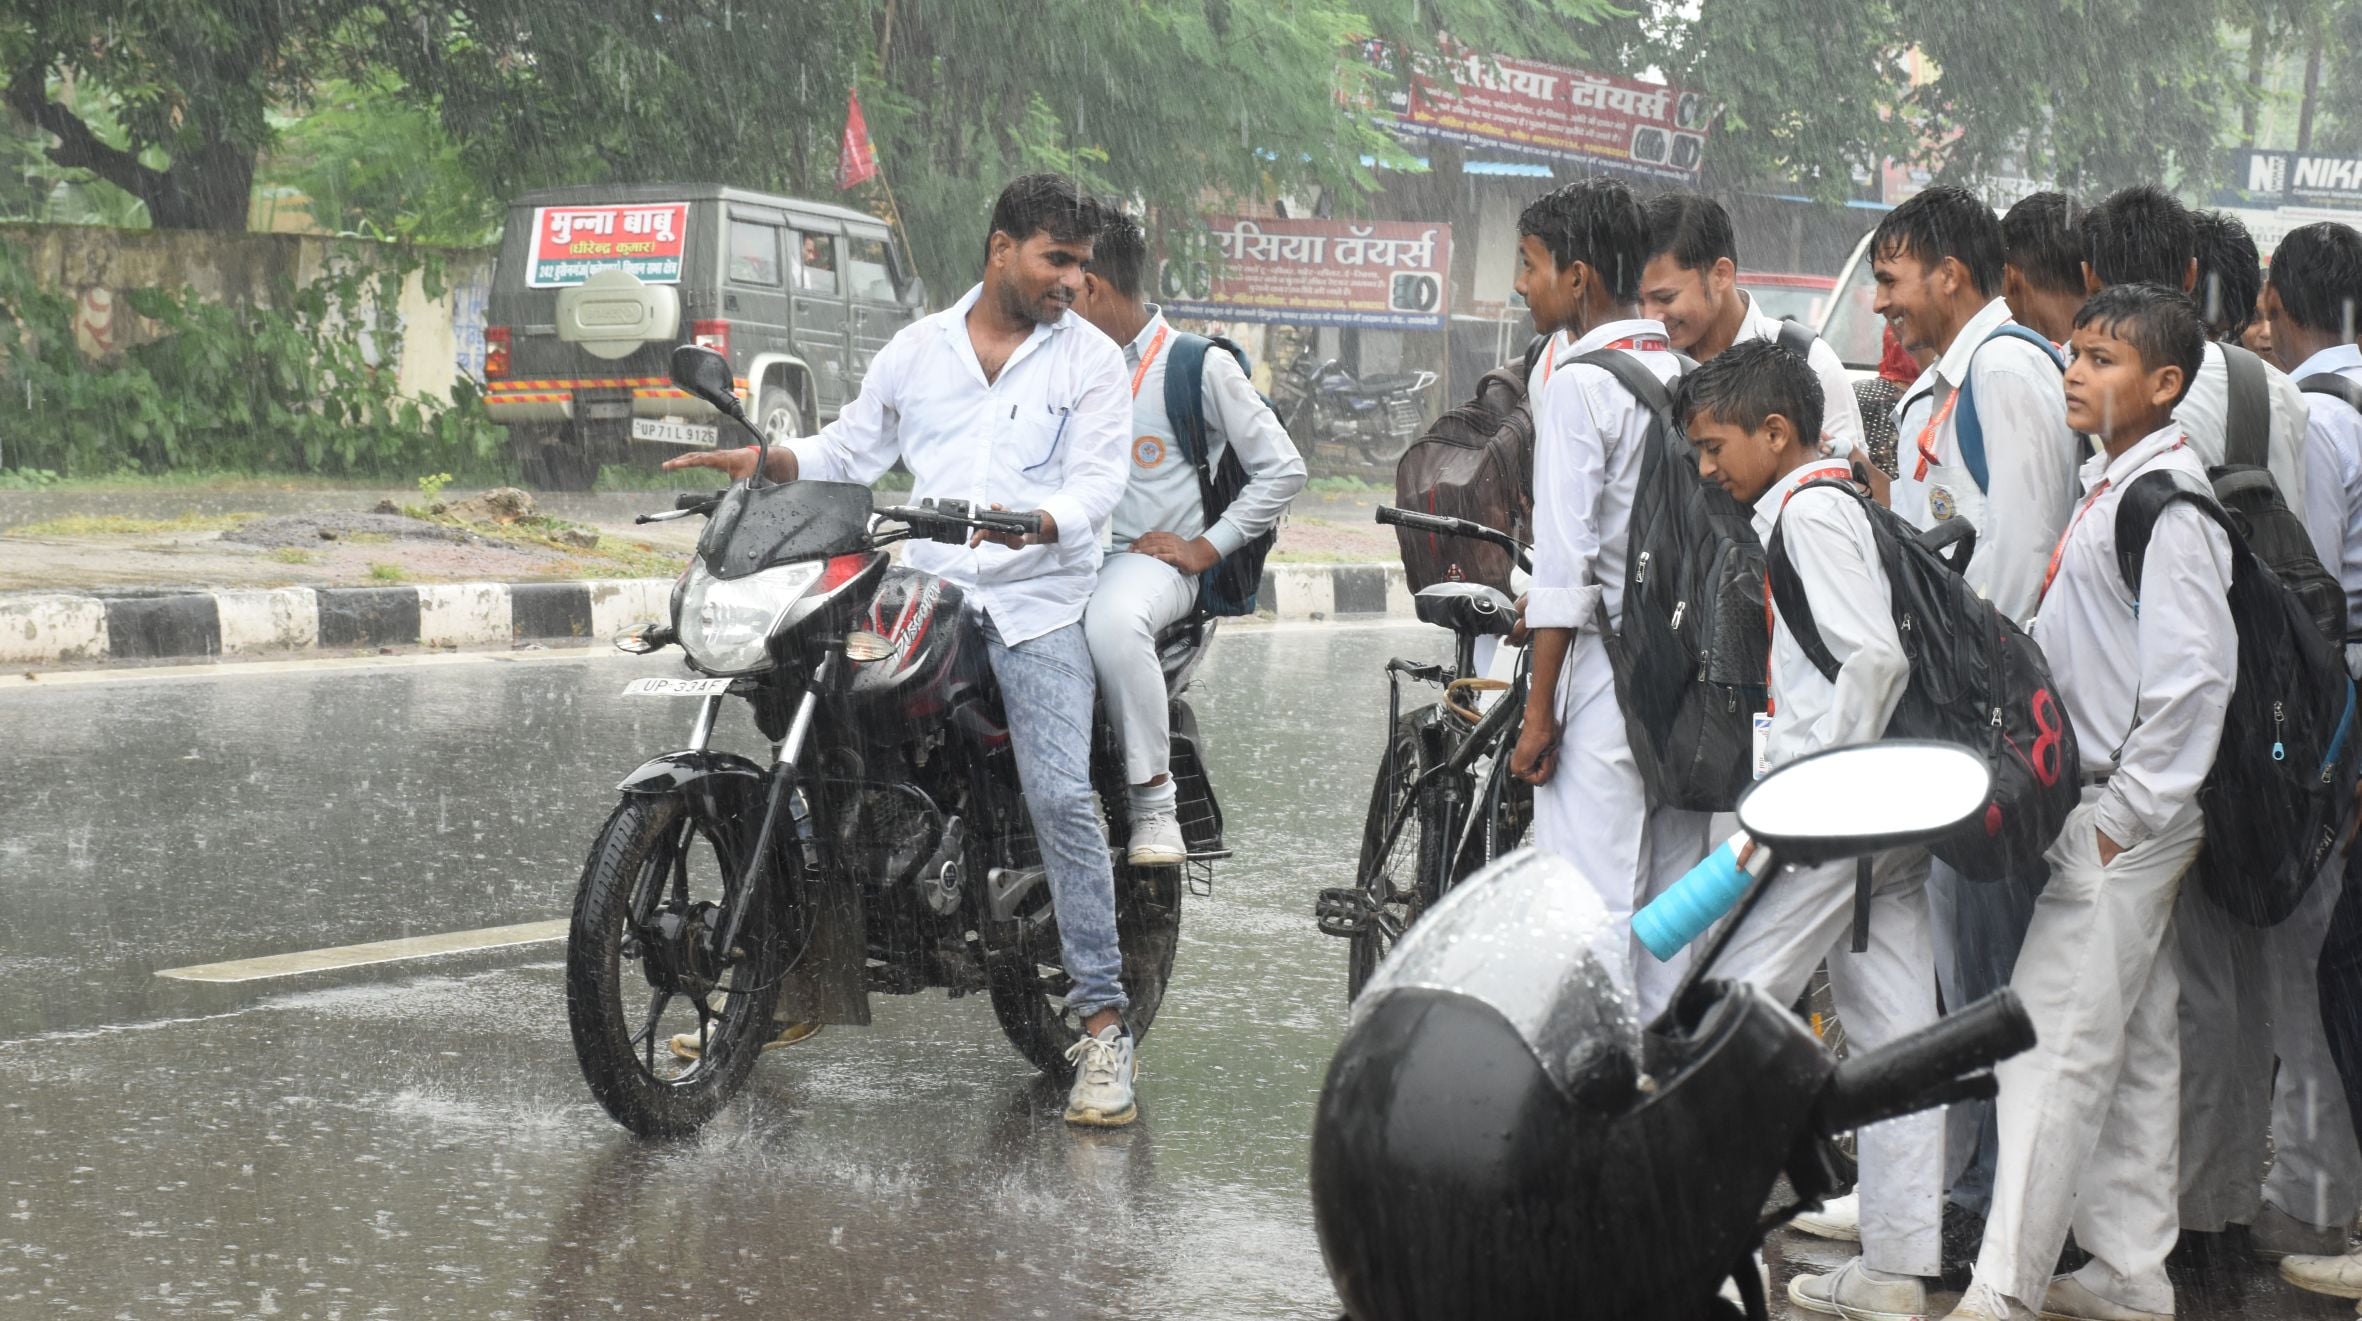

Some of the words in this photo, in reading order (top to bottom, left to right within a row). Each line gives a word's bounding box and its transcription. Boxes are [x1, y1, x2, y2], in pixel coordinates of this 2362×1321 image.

[551, 211, 617, 244] मुन्ना
[623, 209, 676, 242] बाबू
[641, 424, 655, 436] UP
[658, 425, 671, 438] 71
[675, 426, 682, 439] L
